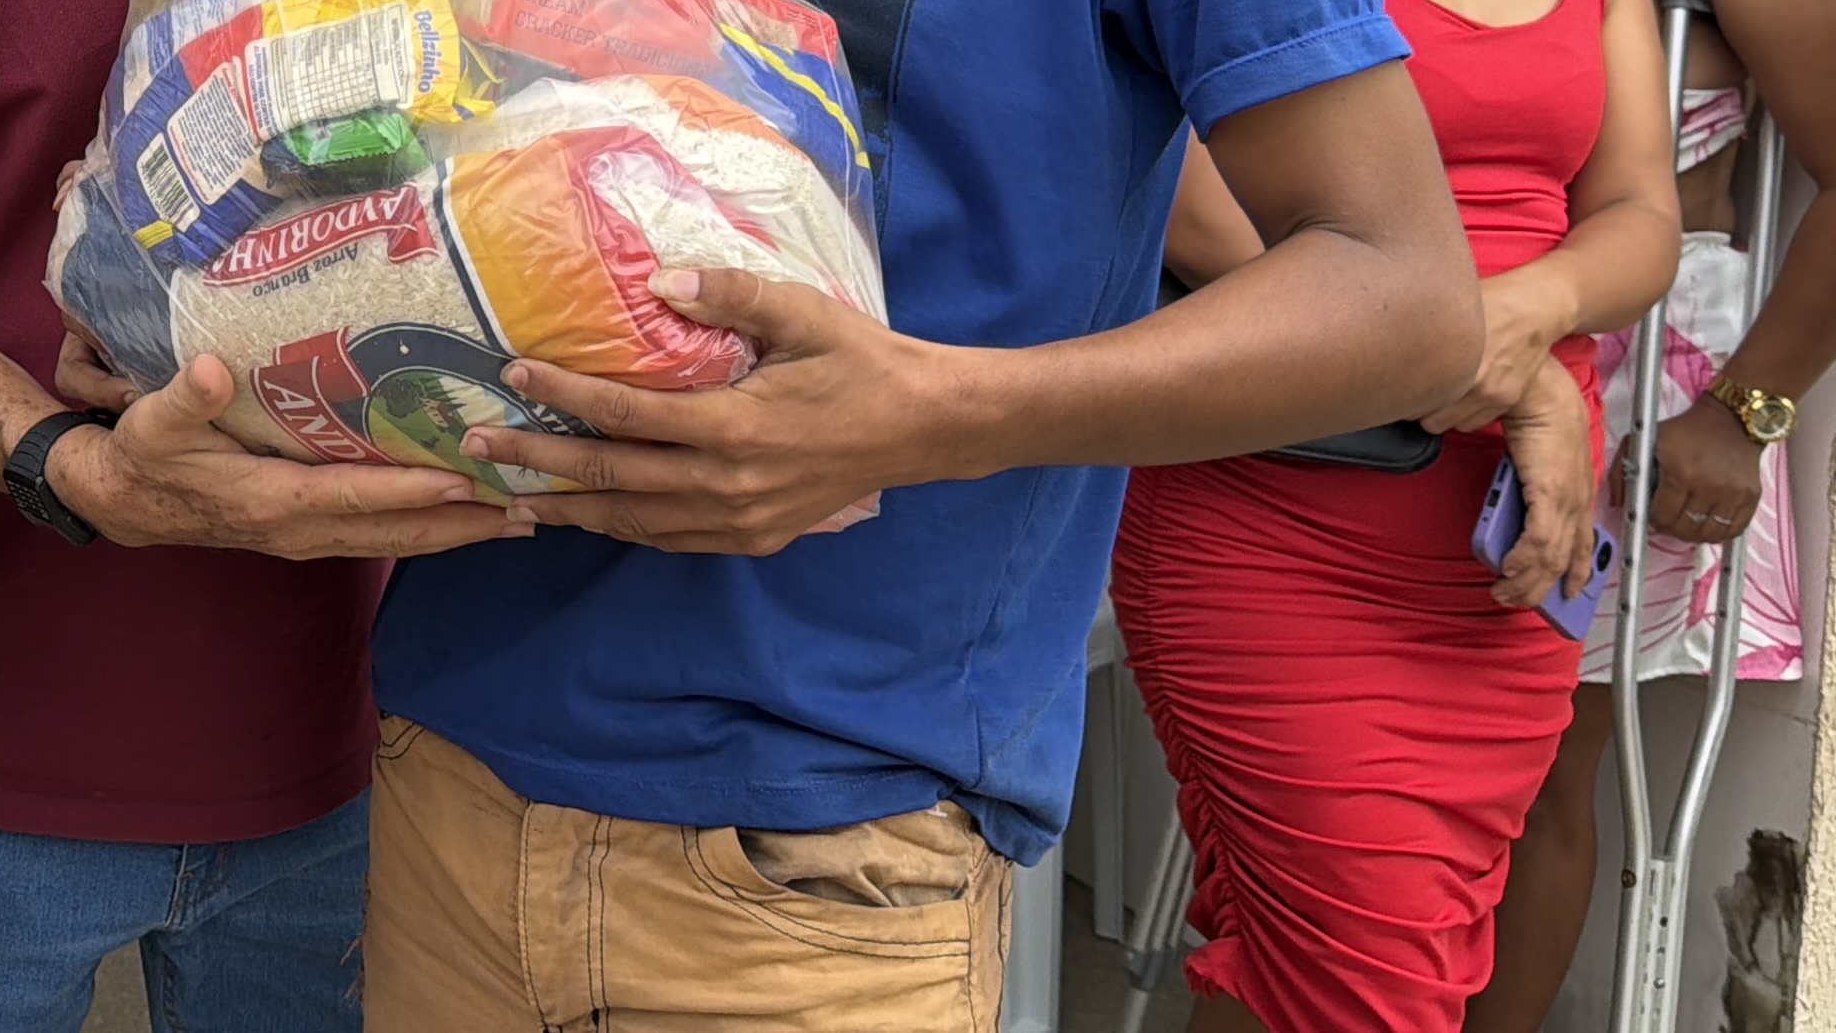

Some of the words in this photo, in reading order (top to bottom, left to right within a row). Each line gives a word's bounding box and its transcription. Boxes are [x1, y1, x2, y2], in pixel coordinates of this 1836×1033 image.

[514, 10, 598, 48] CRACKER
[415, 10, 442, 94] Bellzinho
[314, 242, 358, 272] Arroz
[253, 266, 312, 297] Branco
